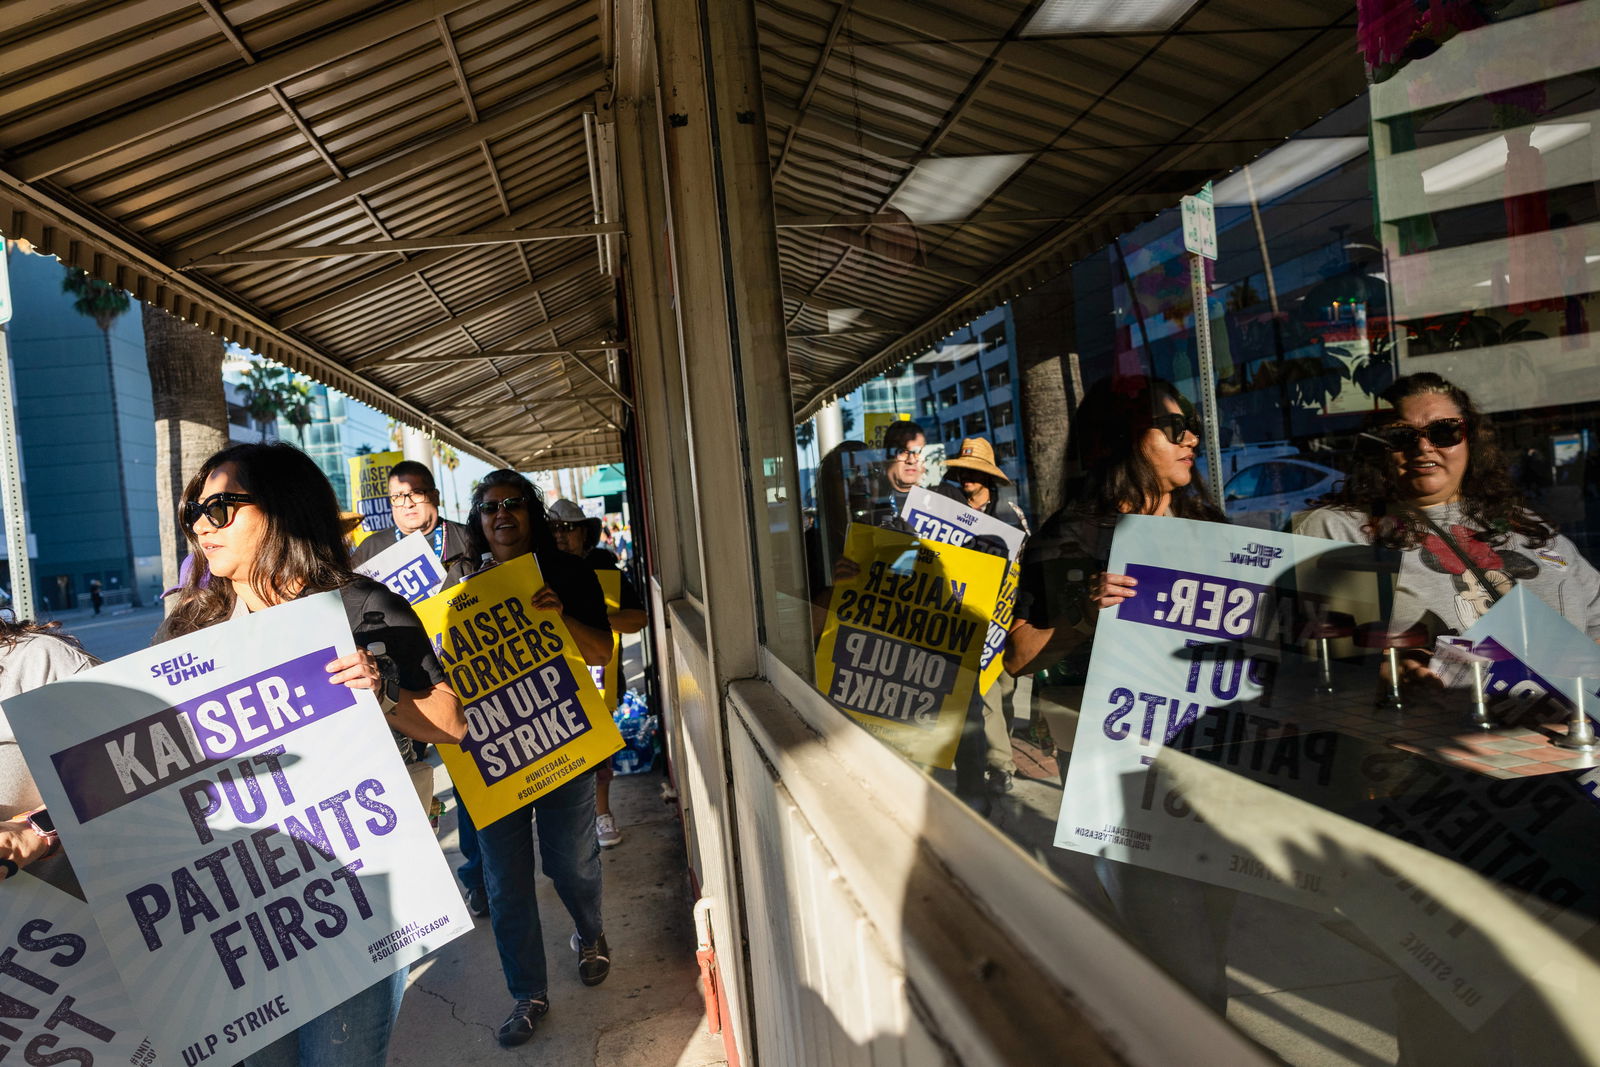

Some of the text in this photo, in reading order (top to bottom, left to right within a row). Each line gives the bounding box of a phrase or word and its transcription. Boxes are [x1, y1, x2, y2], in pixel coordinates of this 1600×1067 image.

[362, 513, 394, 531] STRIK
[374, 497, 392, 513] UL
[455, 596, 479, 611] UHW
[150, 653, 199, 678] SEIU-
[166, 658, 216, 687] UHW
[447, 620, 564, 699] ORKERS
[464, 694, 512, 742] ON
[506, 665, 561, 719] ULP
[104, 676, 315, 795] KAISER:
[480, 698, 585, 778] STRIKE
[179, 743, 296, 845] PUT
[517, 756, 587, 801] #SOLIDARITYSEASON
[525, 754, 571, 784] #UNITED4ALL
[126, 778, 398, 953] PATIENTS
[210, 858, 373, 991] FIRST
[367, 920, 420, 955] #UNITED4ALL
[371, 914, 451, 964] #SOLIDARITYSEASON
[181, 1033, 219, 1067] ULP
[223, 994, 290, 1046] STRIKE
